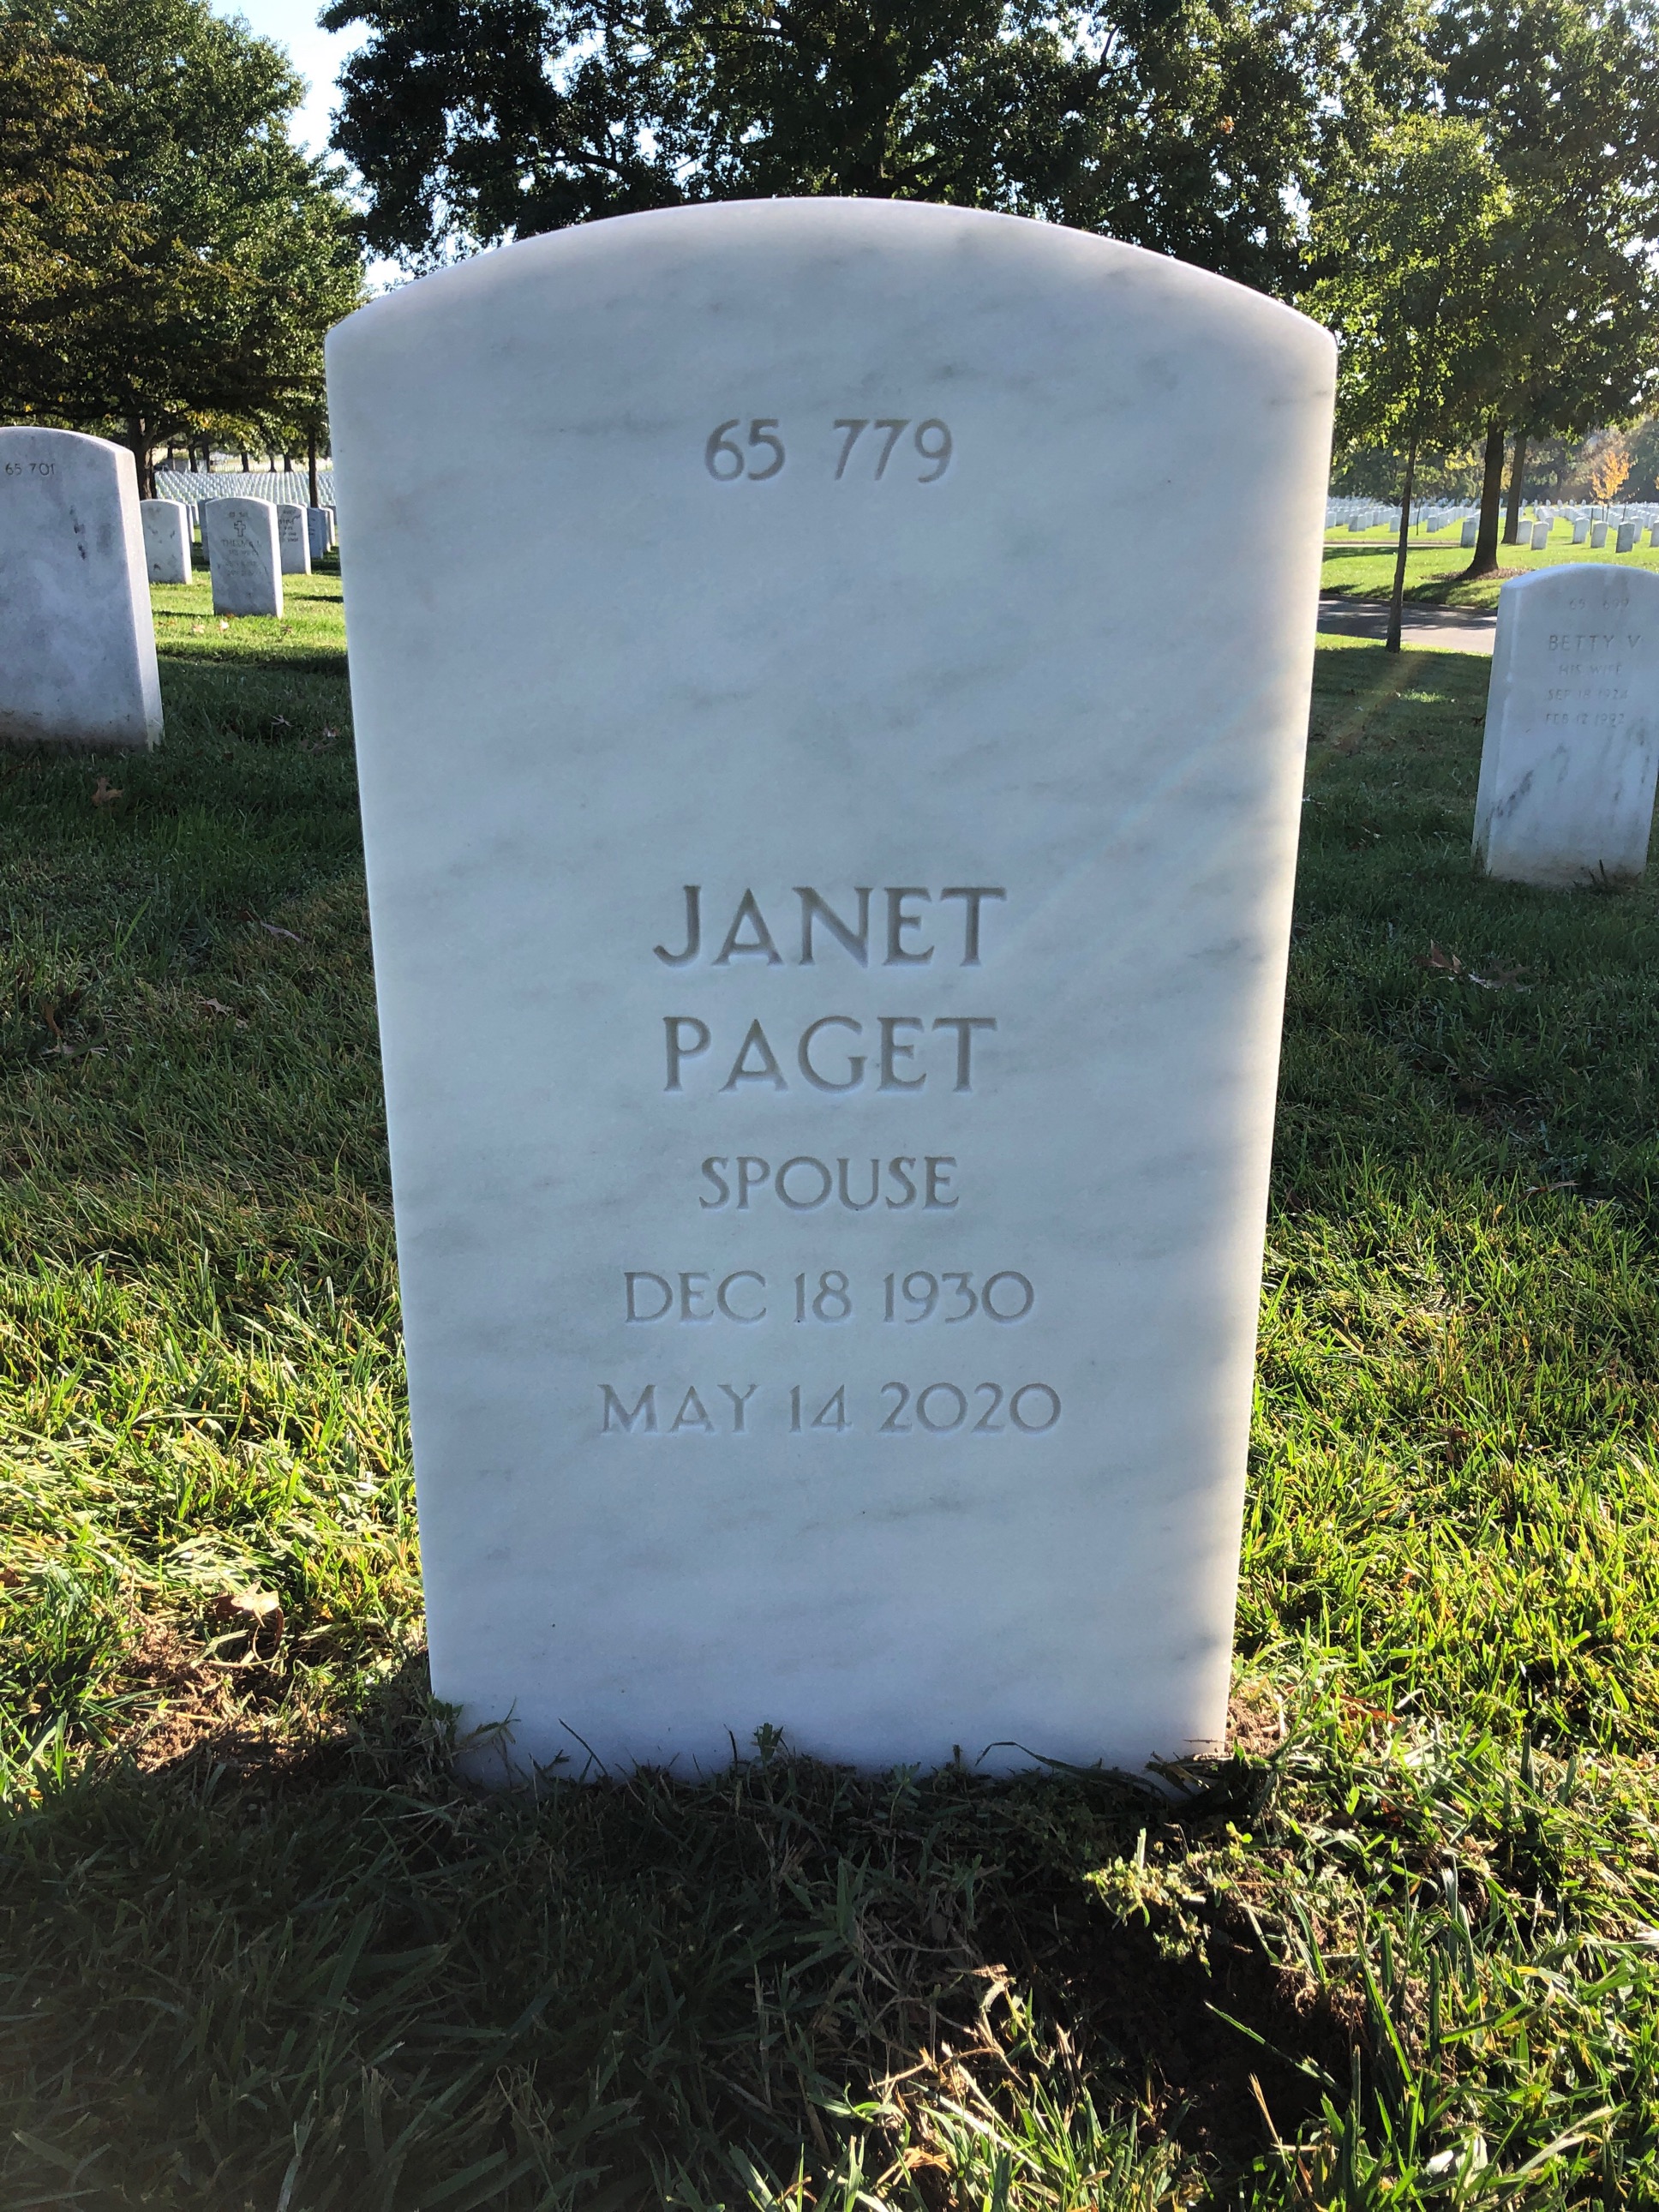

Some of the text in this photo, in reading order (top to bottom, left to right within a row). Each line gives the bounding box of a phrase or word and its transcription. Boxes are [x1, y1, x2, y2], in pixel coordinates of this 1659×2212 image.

[5, 462, 56, 476] 65 701
[704, 418, 953, 483] 65 779
[1548, 634, 1642, 652] BETTY V
[1545, 713, 1569, 725] FEB
[652, 884, 1008, 968] JANET
[662, 1015, 999, 1094] PAGET
[698, 1155, 960, 1211] SPOUSE
[623, 1270, 1035, 1324] DEC 18 1930
[596, 1381, 1062, 1435] MAY 14 2020
